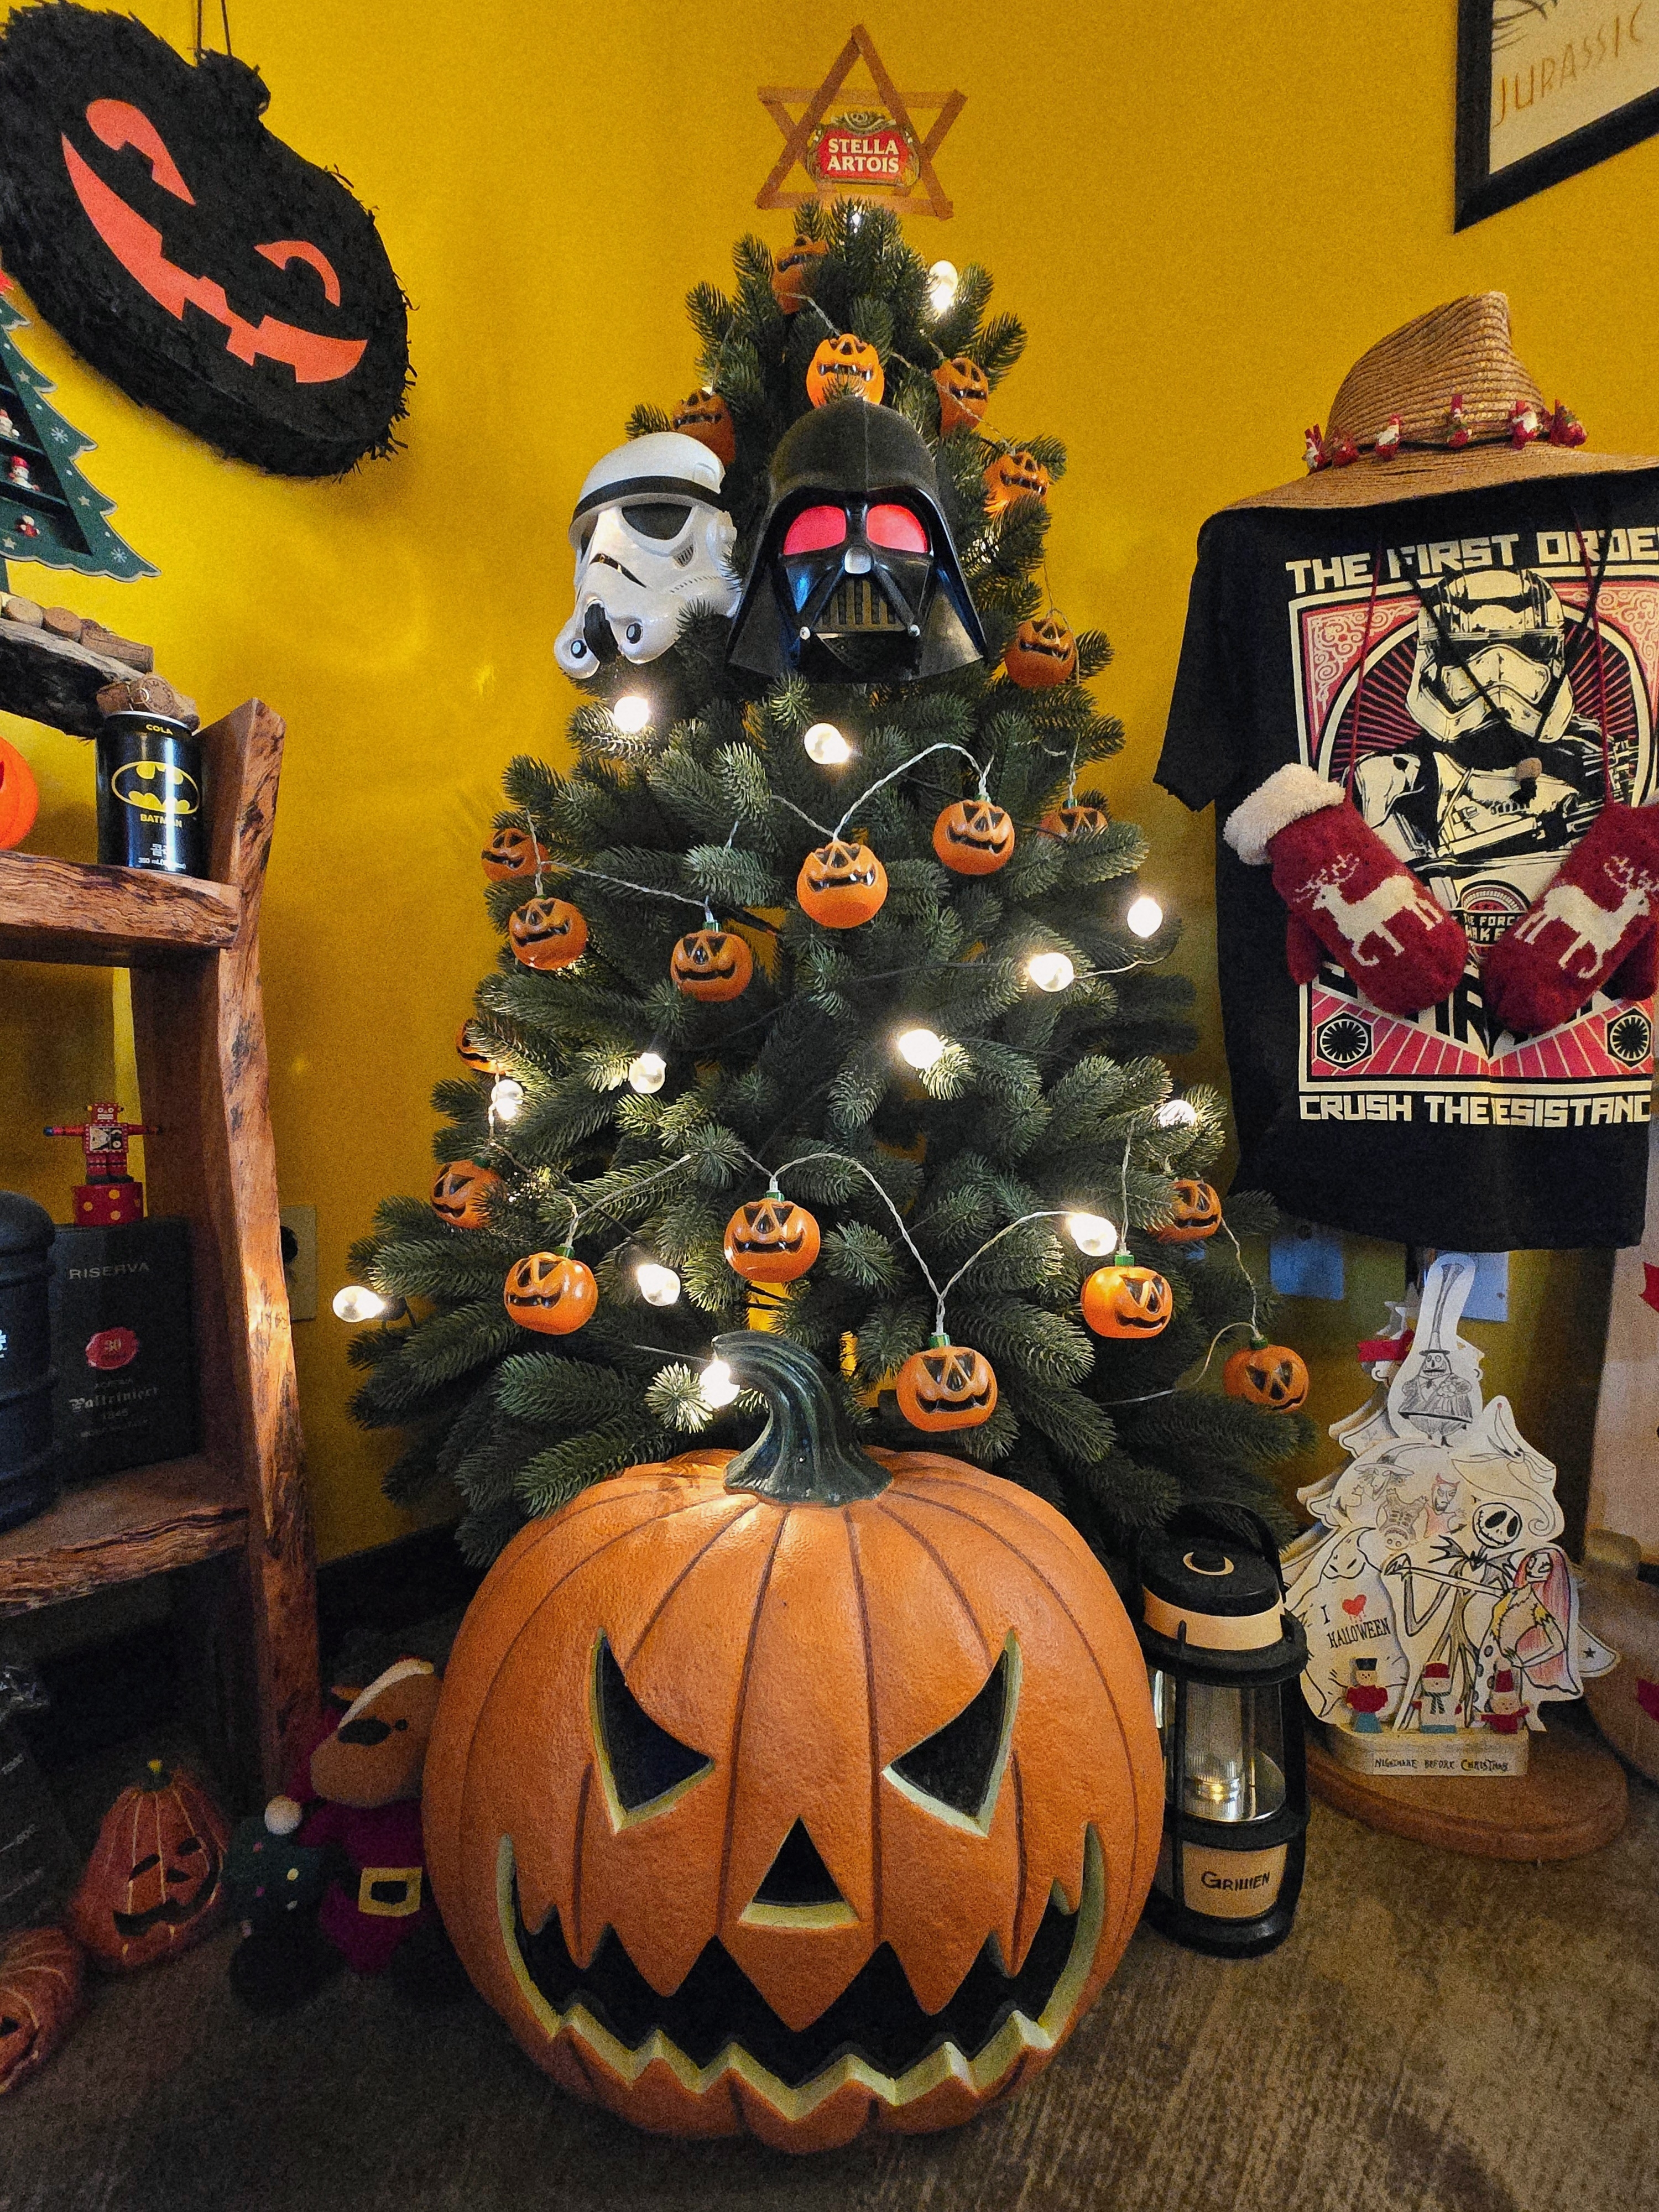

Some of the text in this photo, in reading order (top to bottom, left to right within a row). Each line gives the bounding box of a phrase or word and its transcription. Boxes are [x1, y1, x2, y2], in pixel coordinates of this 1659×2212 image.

[1492, 1, 1643, 129] JURASSIC
[828, 138, 899, 155] STELLA
[827, 155, 899, 173] ARTOIS
[1285, 526, 1659, 594] THE FIRST ORDE
[145, 723, 174, 736] COLA
[140, 813, 182, 828] BATMN
[1479, 916, 1522, 926] FORC
[1299, 1094, 1651, 1128] CRUSH THE ESISTANC
[69, 1262, 150, 1280] RISERVA
[1320, 1604, 1331, 1625] I
[1326, 1617, 1391, 1649] HALLOWEEN
[1424, 1759, 1455, 1770] BEFORE
